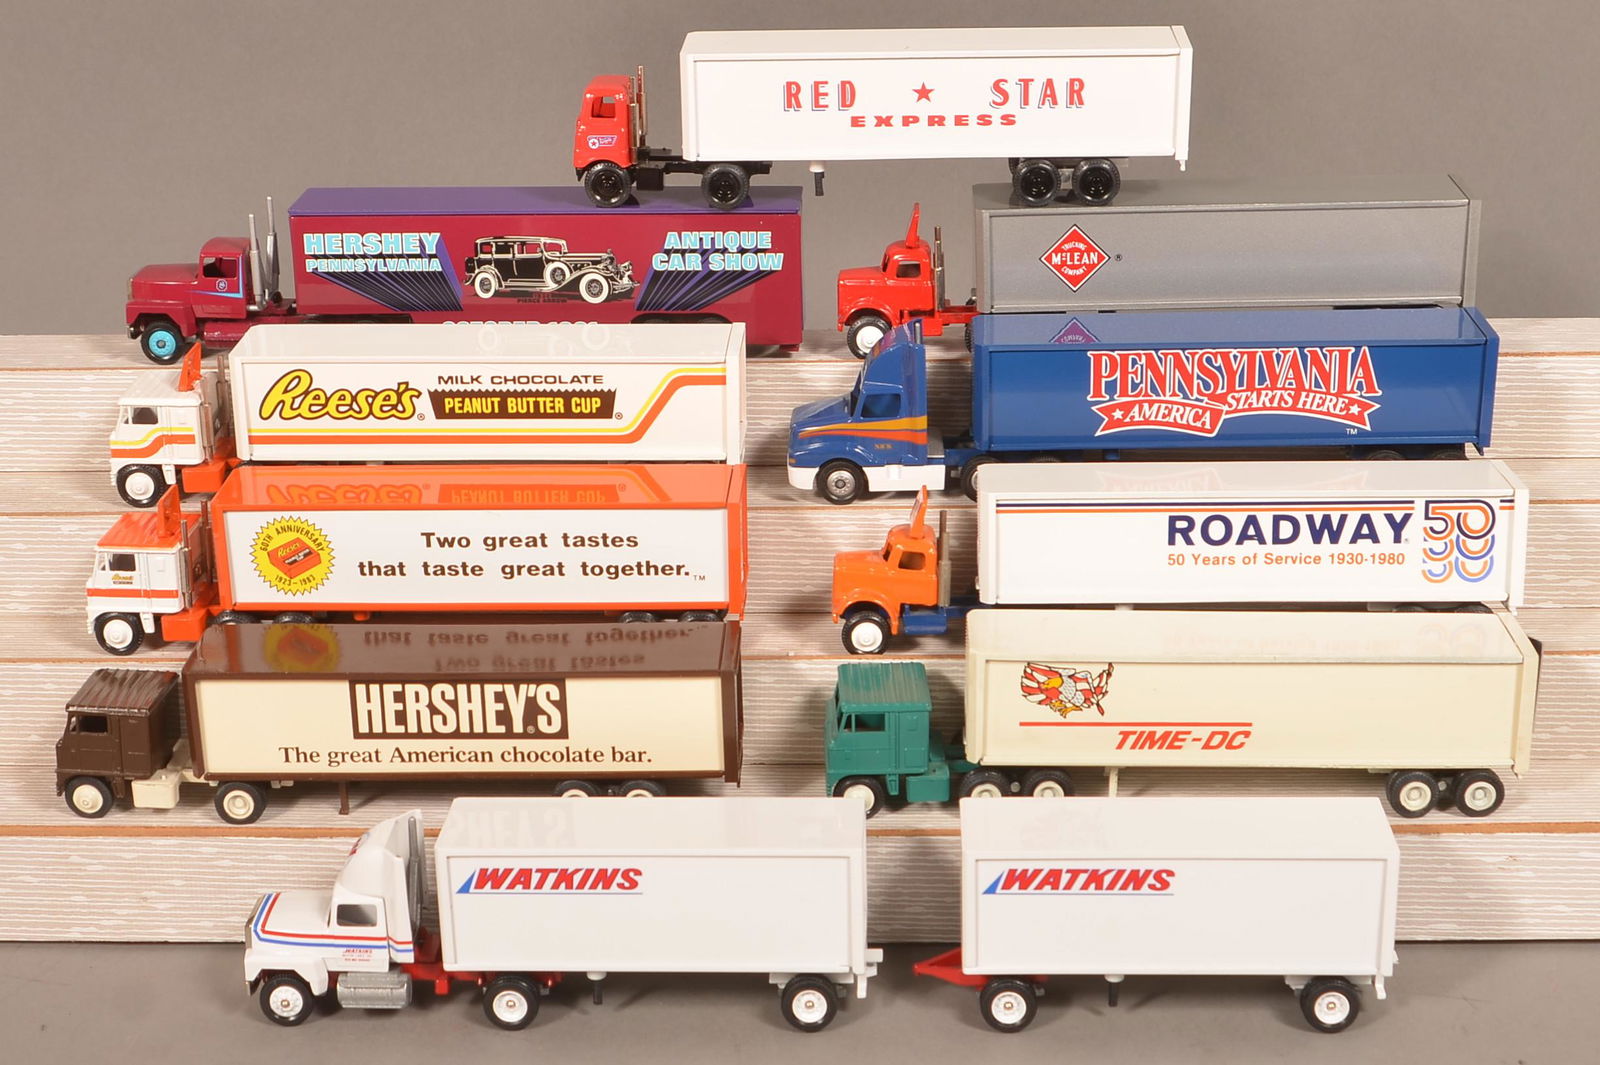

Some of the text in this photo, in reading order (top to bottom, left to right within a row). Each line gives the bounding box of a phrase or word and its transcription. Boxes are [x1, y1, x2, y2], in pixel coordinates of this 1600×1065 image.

[783, 77, 1085, 112] RED STAR
[850, 114, 1017, 128] EXPRESS
[303, 232, 441, 255] HERSHEY
[664, 231, 772, 252] ANTIQUE
[1061, 241, 1088, 251] TRUCKING
[305, 258, 442, 273] PENNSYLVANIA
[652, 253, 784, 271] CAR SHOW
[1061, 265, 1087, 276] COMPANY
[438, 375, 604, 385] MILK CHOCOLATE
[1087, 346, 1382, 401] PENNSYLVANIA
[259, 368, 422, 421] Reese's
[444, 397, 602, 414] PEANUT BUTTER CUP
[1124, 389, 1349, 430] AMERICA STARTS HERE
[260, 524, 325, 552] 60TH ANNIVERSARY
[1167, 513, 1414, 546] ROADWAY
[421, 532, 639, 551] Two great tastes
[1168, 552, 1405, 566] 50 Years of Service 1930-1980
[358, 560, 690, 580] that taste great together.
[354, 683, 563, 734] HERSHEY'S
[1115, 730, 1252, 750] TIME-DC
[278, 745, 652, 767] The great American chocolate bar.
[473, 868, 643, 891] WATKINS
[1000, 868, 1176, 891] WATKINS
